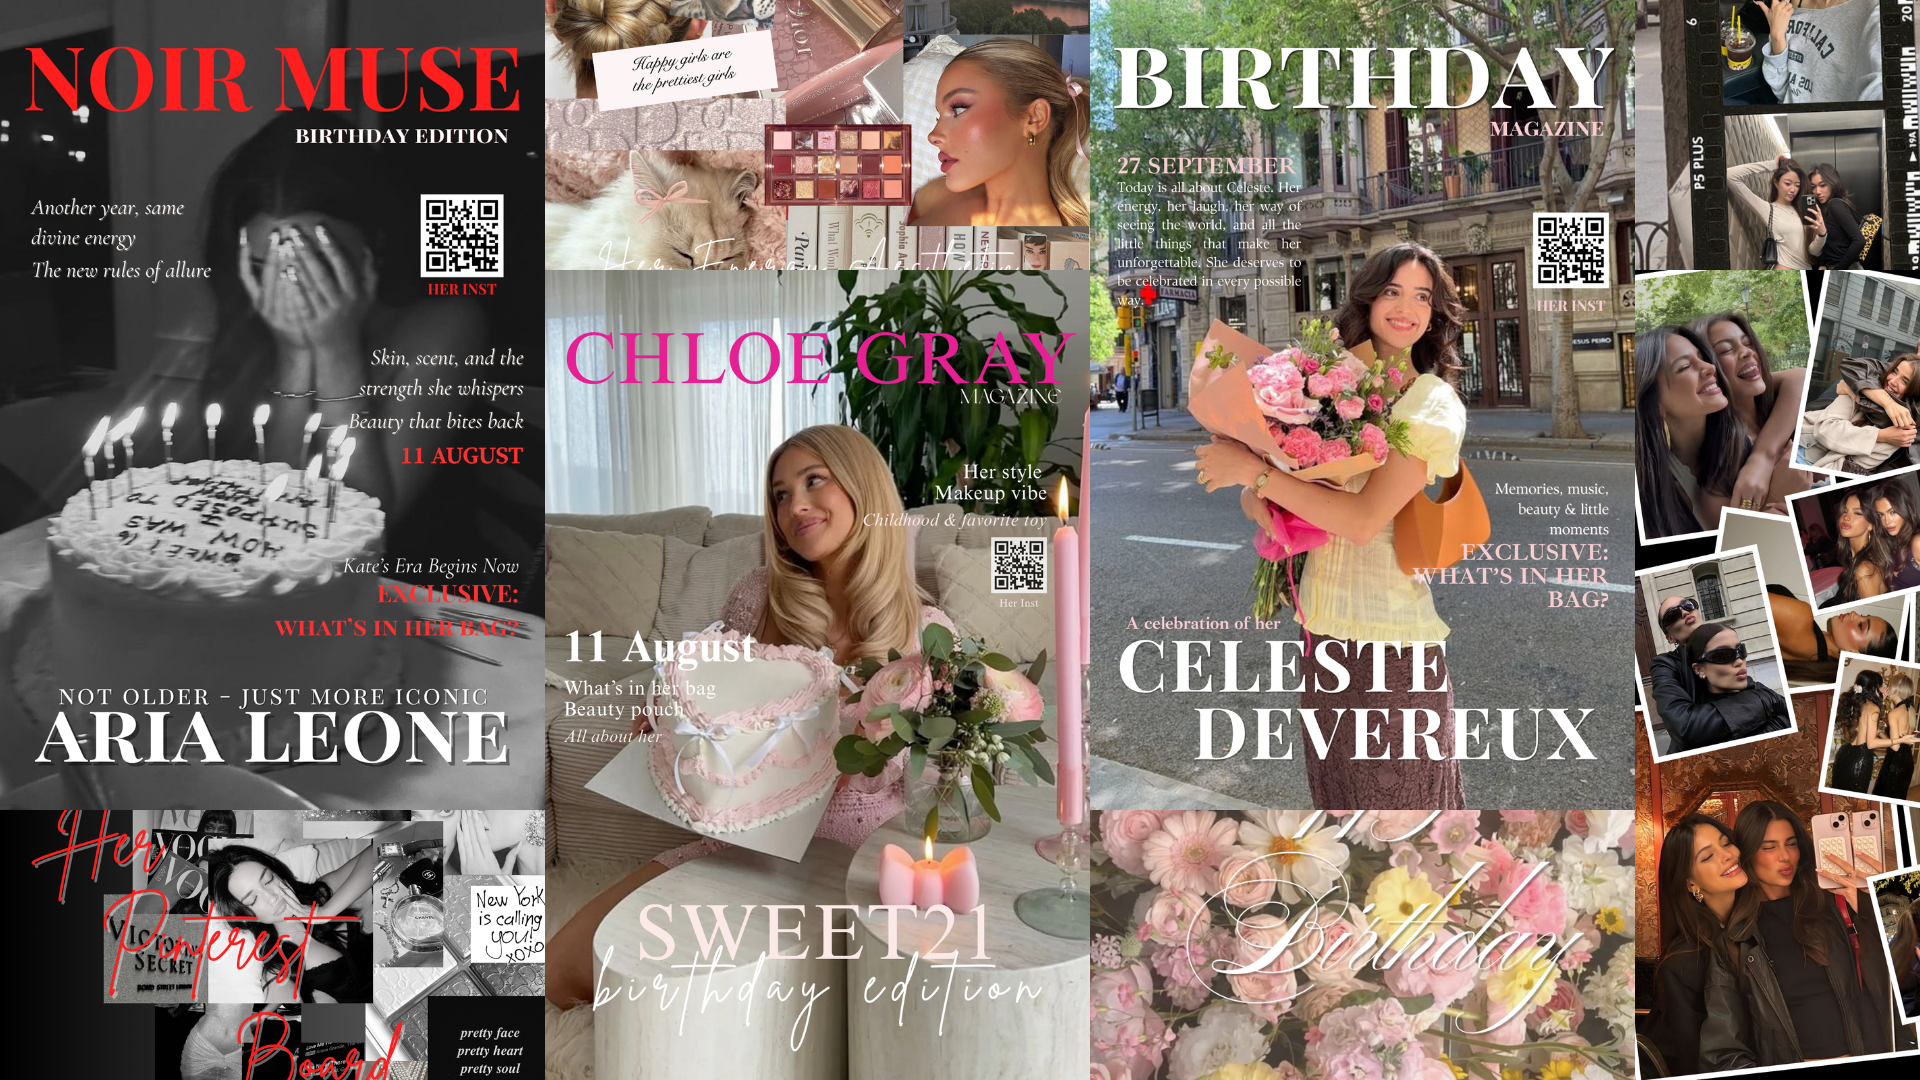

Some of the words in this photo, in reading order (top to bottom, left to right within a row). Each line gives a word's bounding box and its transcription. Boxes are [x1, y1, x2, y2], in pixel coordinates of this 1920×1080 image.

[1902, 6, 1913, 22] 20
[632, 55, 678, 74] Happy
[674, 48, 709, 70] girls
[712, 50, 732, 60] are
[632, 77, 654, 92] the
[652, 73, 706, 94] prettiest
[702, 66, 736, 88] girls
[1692, 137, 1704, 169] PLUS
[1694, 174, 1705, 189] P5
[1160, 288, 1196, 298] FARMACIA
[477, 890, 508, 908] New
[479, 911, 491, 926] is
[496, 910, 543, 932] calling
[486, 926, 533, 960] you!
[134, 950, 193, 976] SECRET
[460, 1029, 493, 1040] pretty
[494, 1027, 520, 1040] face
[456, 1047, 490, 1058] pretty
[493, 1045, 524, 1056] heart
[460, 1065, 493, 1076] pretty
[496, 1063, 521, 1074] soul
